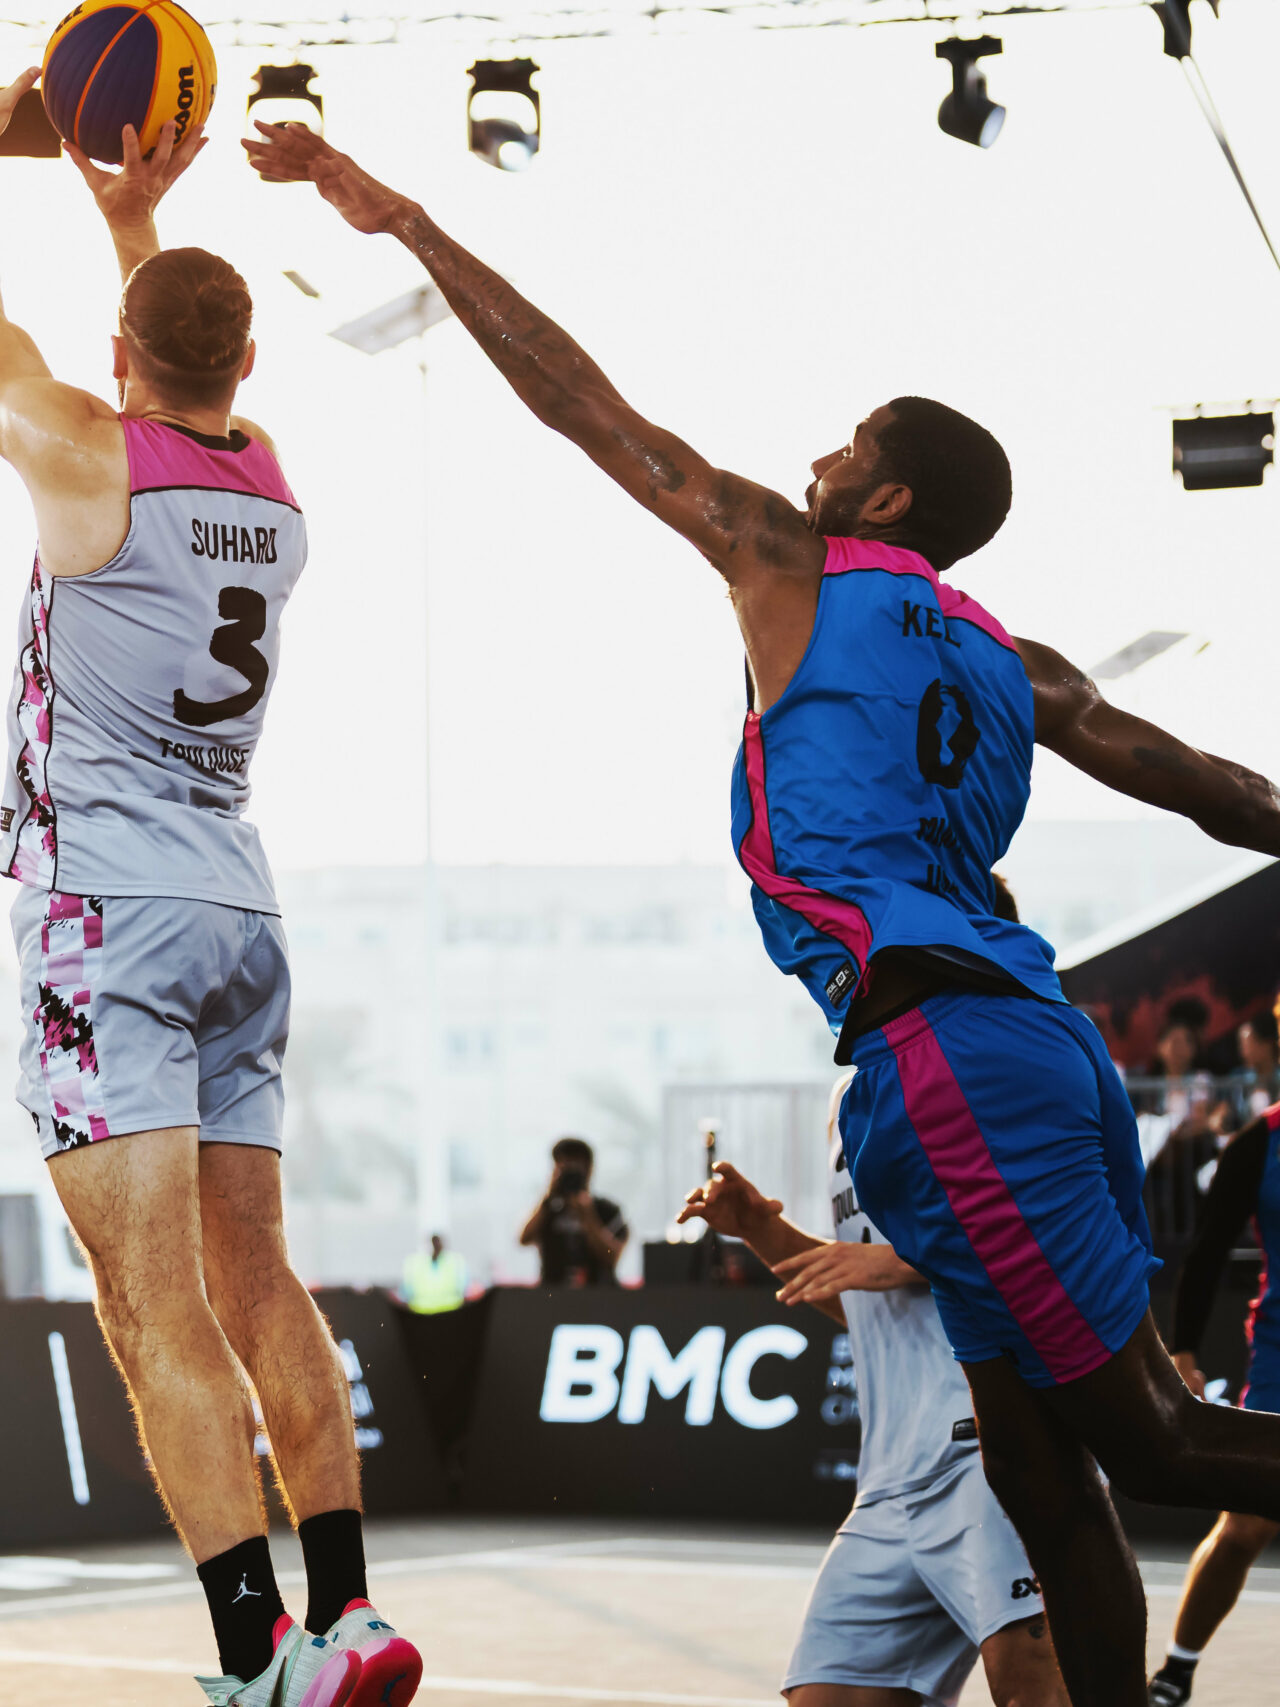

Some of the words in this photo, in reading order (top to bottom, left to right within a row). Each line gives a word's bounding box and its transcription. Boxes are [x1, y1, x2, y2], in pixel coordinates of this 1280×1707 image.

[191, 518, 278, 564] SUHARD
[173, 585, 270, 728] 3
[159, 736, 250, 774] TOULOUSE
[916, 677, 982, 790] 0
[539, 1323, 809, 1430] BMC
